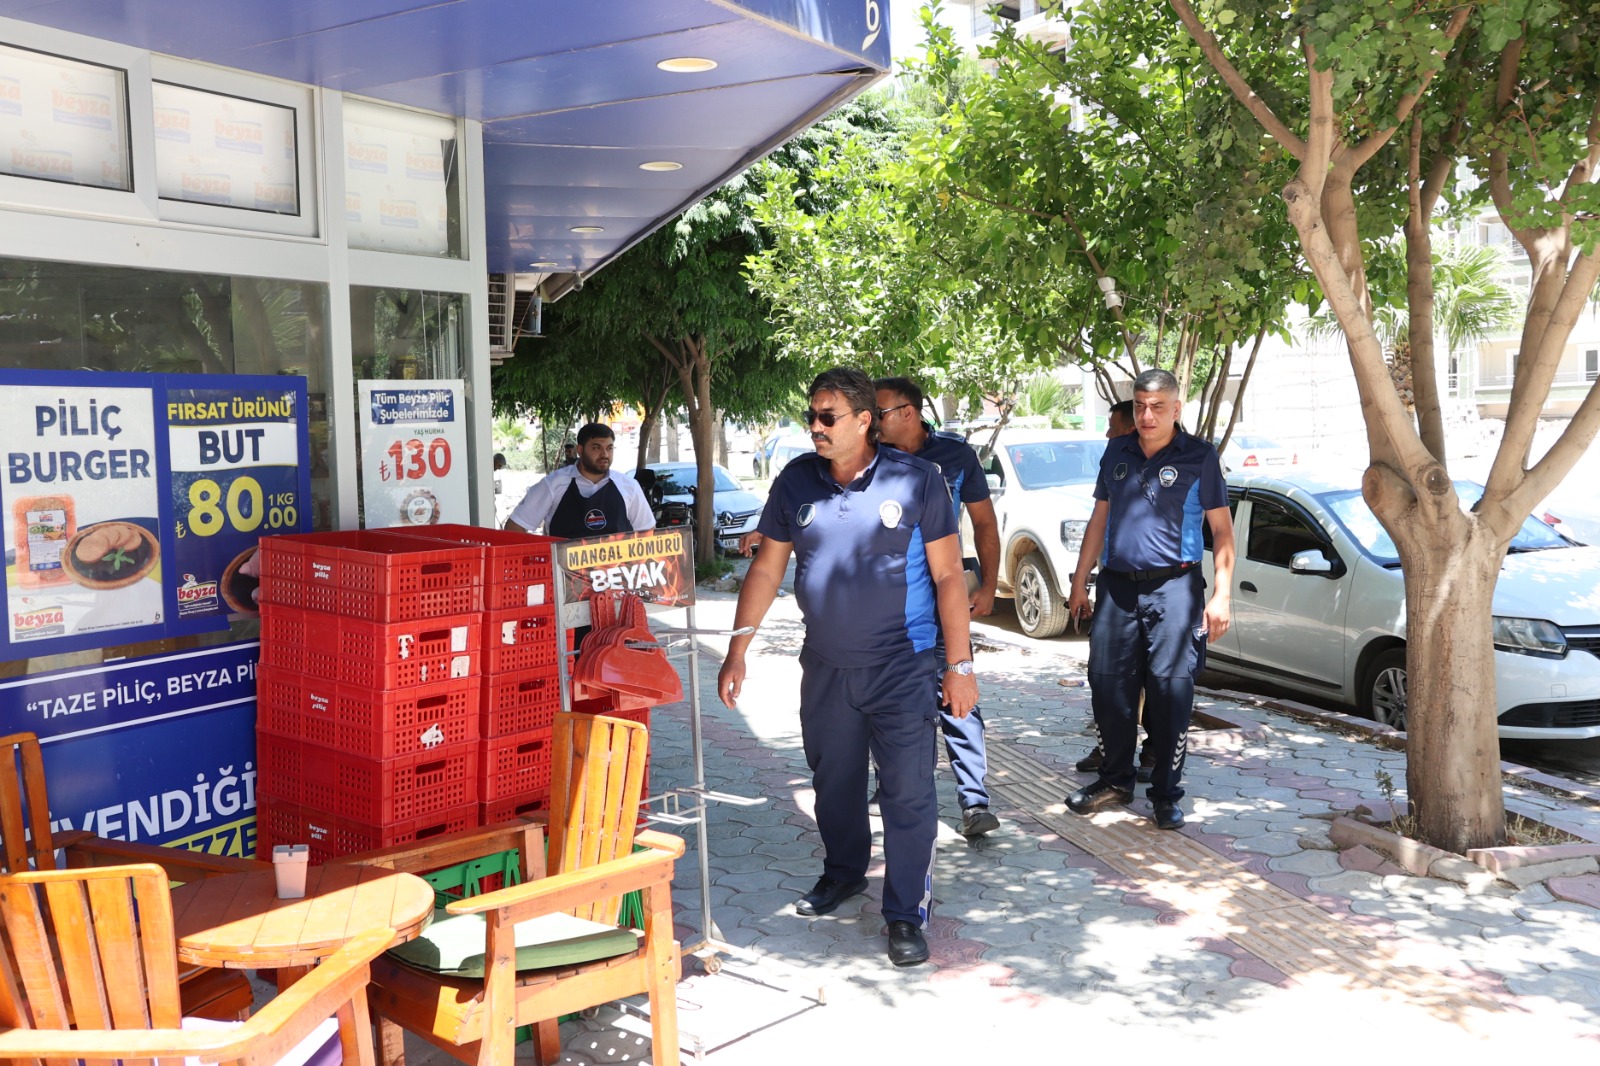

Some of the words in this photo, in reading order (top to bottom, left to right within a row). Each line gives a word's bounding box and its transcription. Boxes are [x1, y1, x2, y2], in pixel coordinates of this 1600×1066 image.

[168, 402, 229, 420] FIRSAT
[232, 396, 291, 418] ÜRÜNÜ
[375, 393, 397, 405] Tüm
[35, 398, 122, 441] PİLİÇ
[380, 408, 449, 424] Şubelerimizde
[198, 428, 265, 465] BUT
[8, 449, 151, 484] BURGER
[277, 492, 294, 505] KG
[569, 545, 623, 567] MANGAL
[628, 534, 680, 558] KÖMÜRÜ
[590, 560, 667, 593] BEYAK
[177, 586, 216, 600] beyza
[13, 612, 64, 628] beyza
[102, 680, 162, 708] PİLİÇ,
[166, 670, 232, 696] BEYZA
